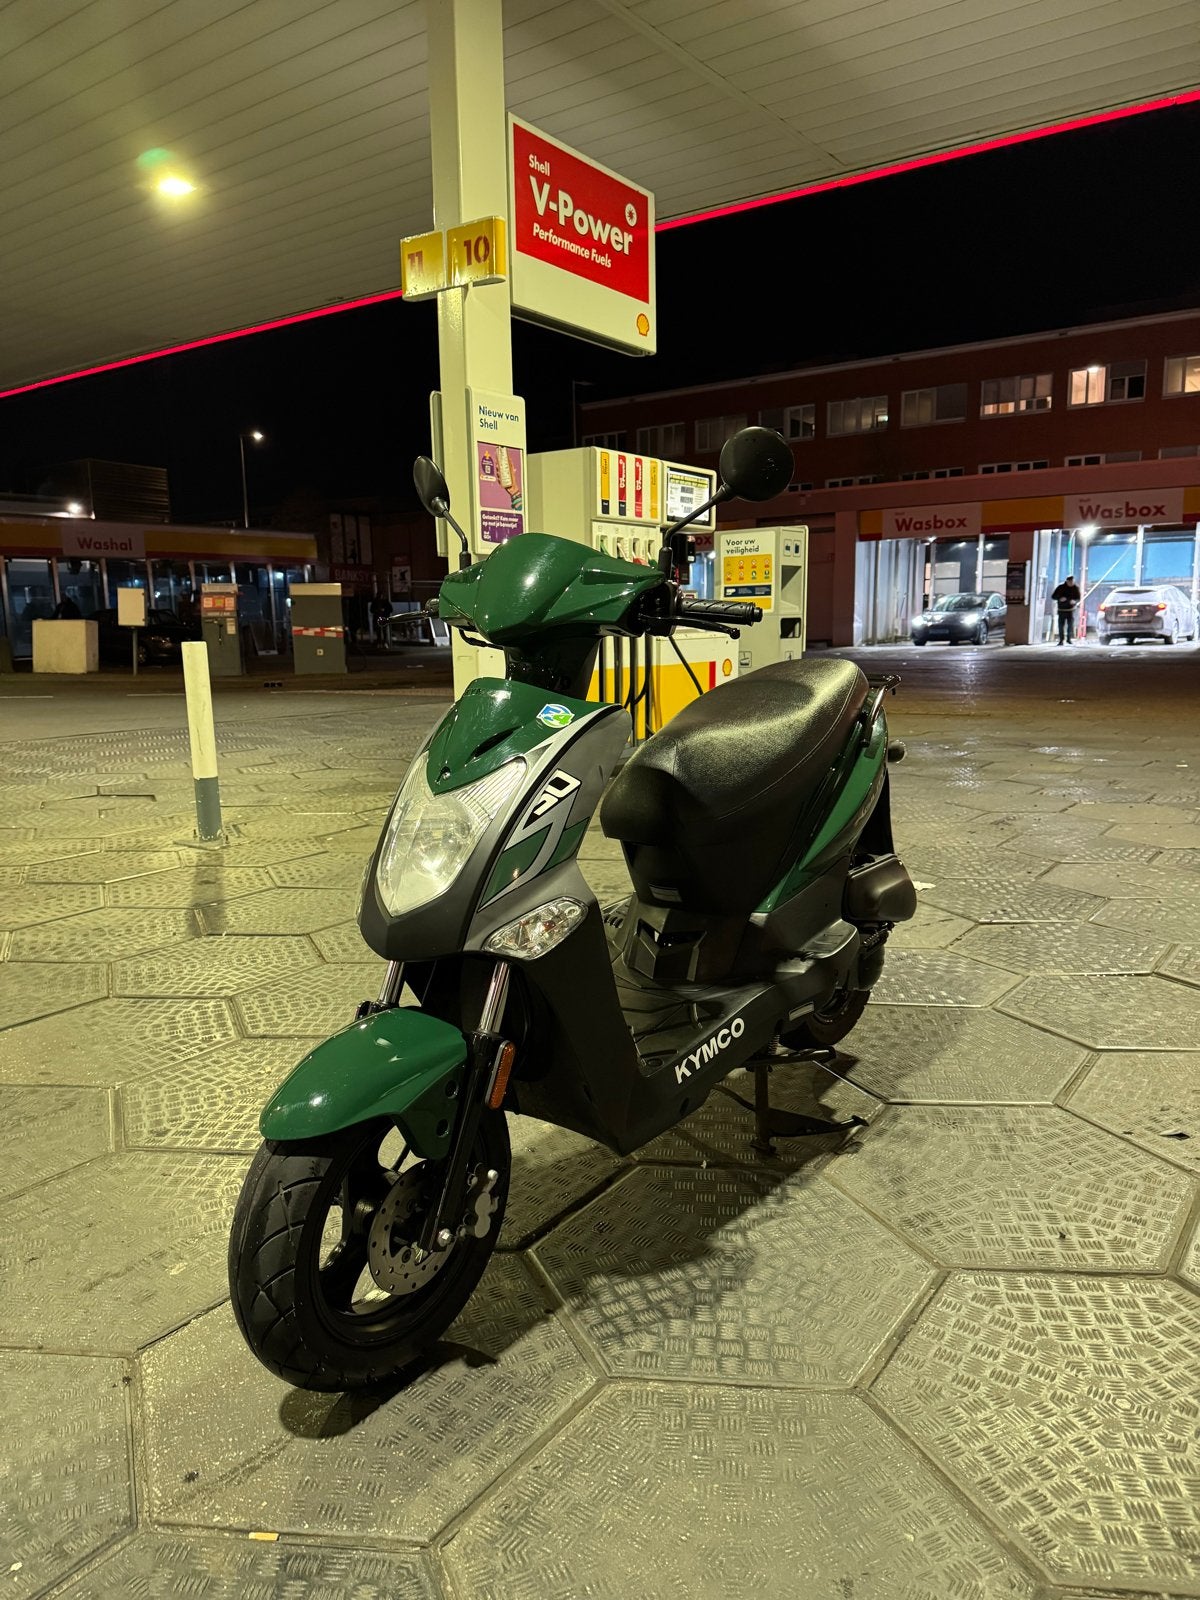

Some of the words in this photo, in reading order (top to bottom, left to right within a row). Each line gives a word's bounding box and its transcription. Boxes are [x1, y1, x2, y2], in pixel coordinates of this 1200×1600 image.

[528, 154, 550, 176] Shell
[529, 175, 634, 256] V-Power
[463, 234, 490, 266] 10
[532, 222, 590, 260] Performance
[590, 247, 612, 269] Fuels
[407, 250, 424, 274] 11
[478, 405, 504, 419] Nieuw
[505, 412, 519, 422] van
[479, 418, 498, 430] Shell
[1078, 500, 1167, 521] Wasbox
[895, 514, 968, 532] Wasbox
[77, 536, 133, 551] Washal
[726, 545, 760, 555] veiligheid
[674, 1017, 745, 1085] KYMCO
